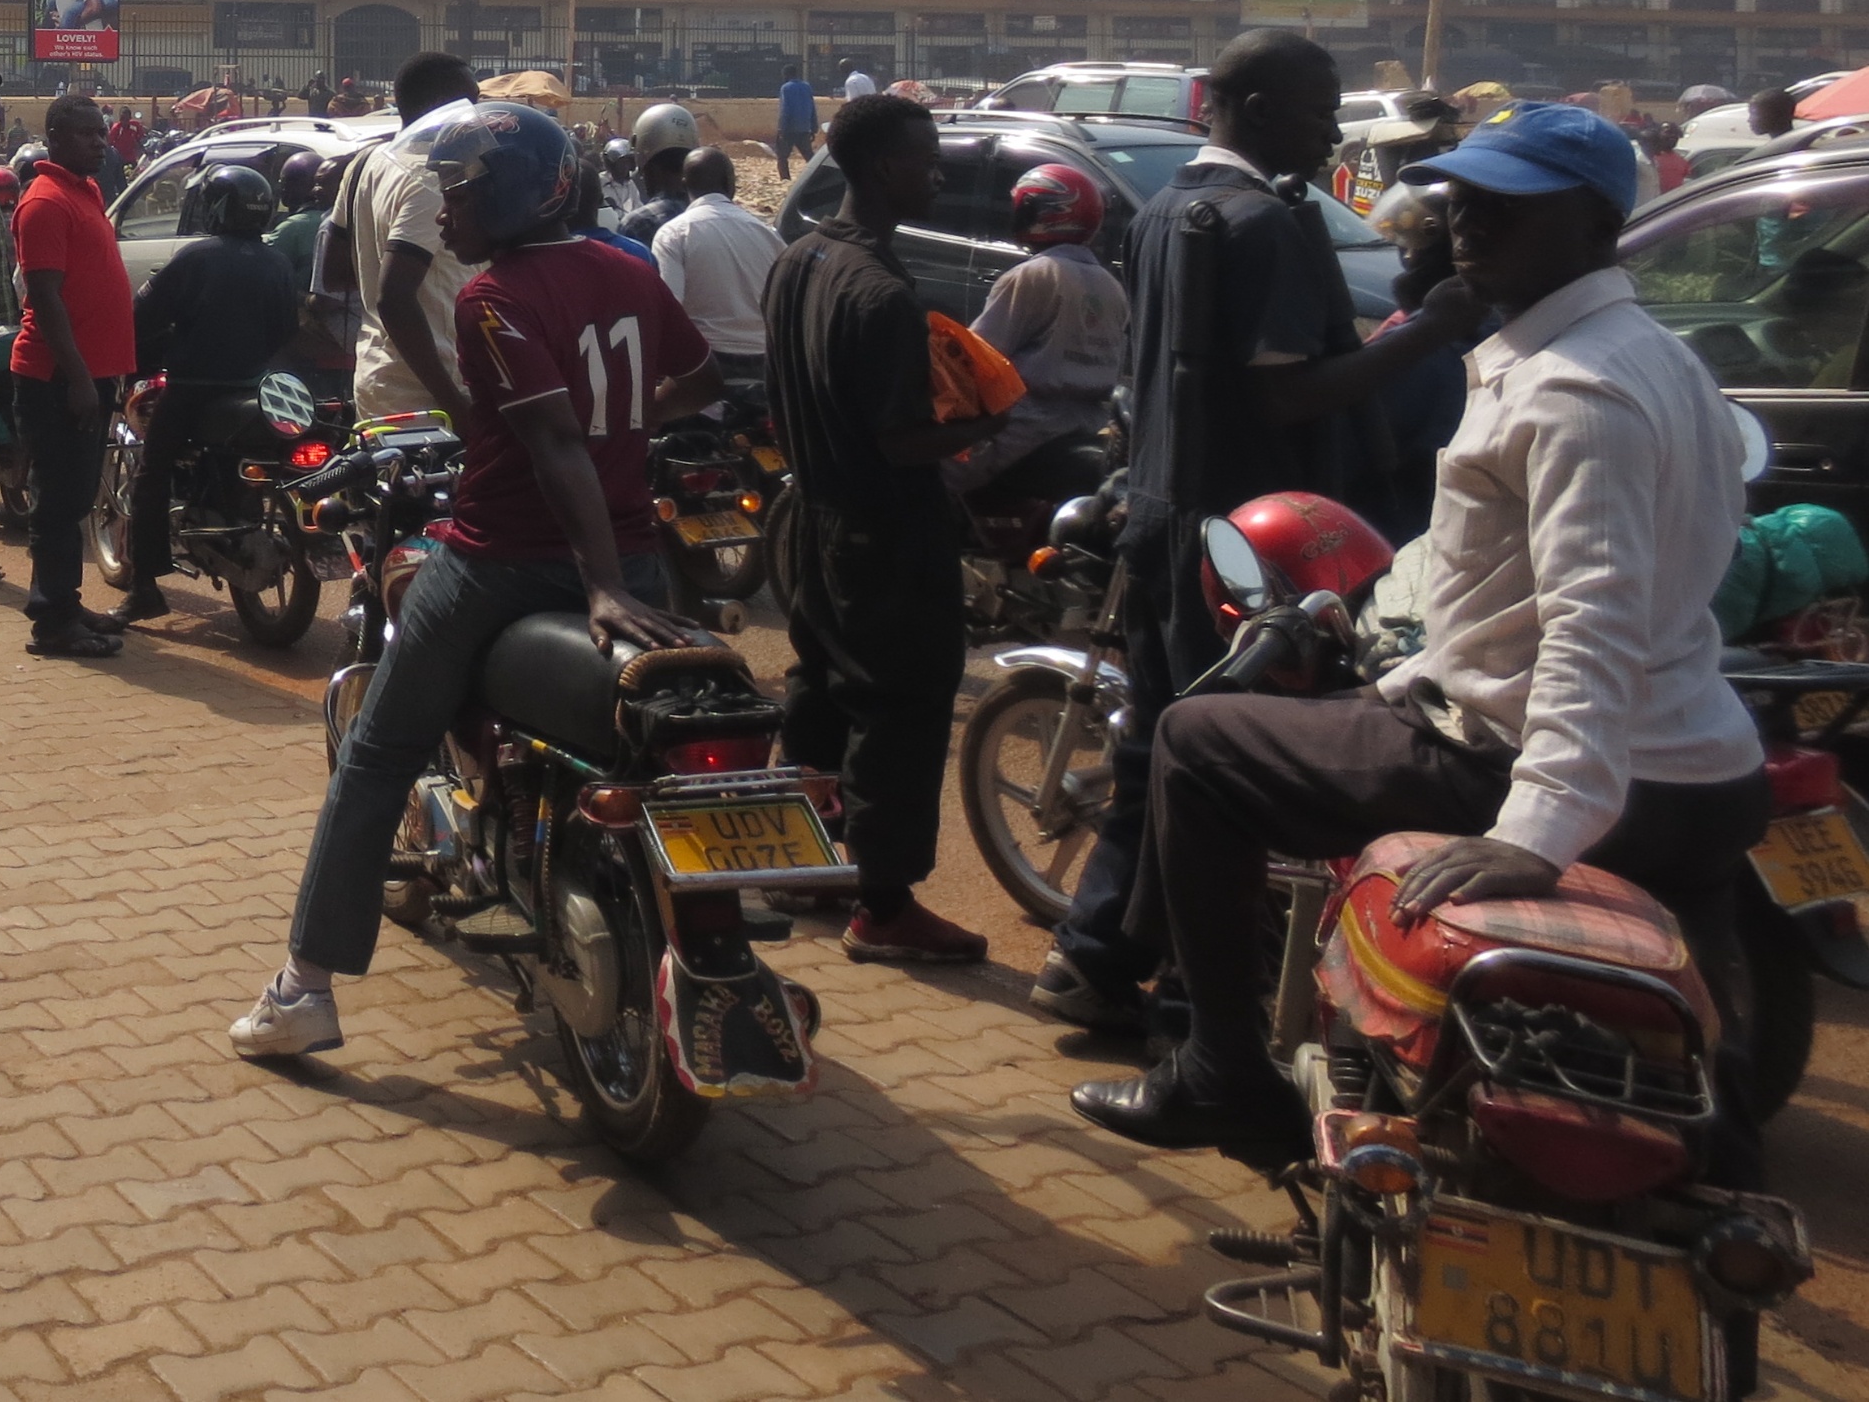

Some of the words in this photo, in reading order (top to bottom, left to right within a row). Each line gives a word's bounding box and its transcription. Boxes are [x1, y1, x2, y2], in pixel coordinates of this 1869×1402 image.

[56, 34, 96, 43] LOVELY!
[578, 315, 643, 436] 11
[709, 804, 787, 840] UDV
[1778, 819, 1842, 855] UEE
[1792, 856, 1864, 896] 3946
[1523, 1224, 1666, 1312] UDT
[1485, 1290, 1672, 1391] 881U
